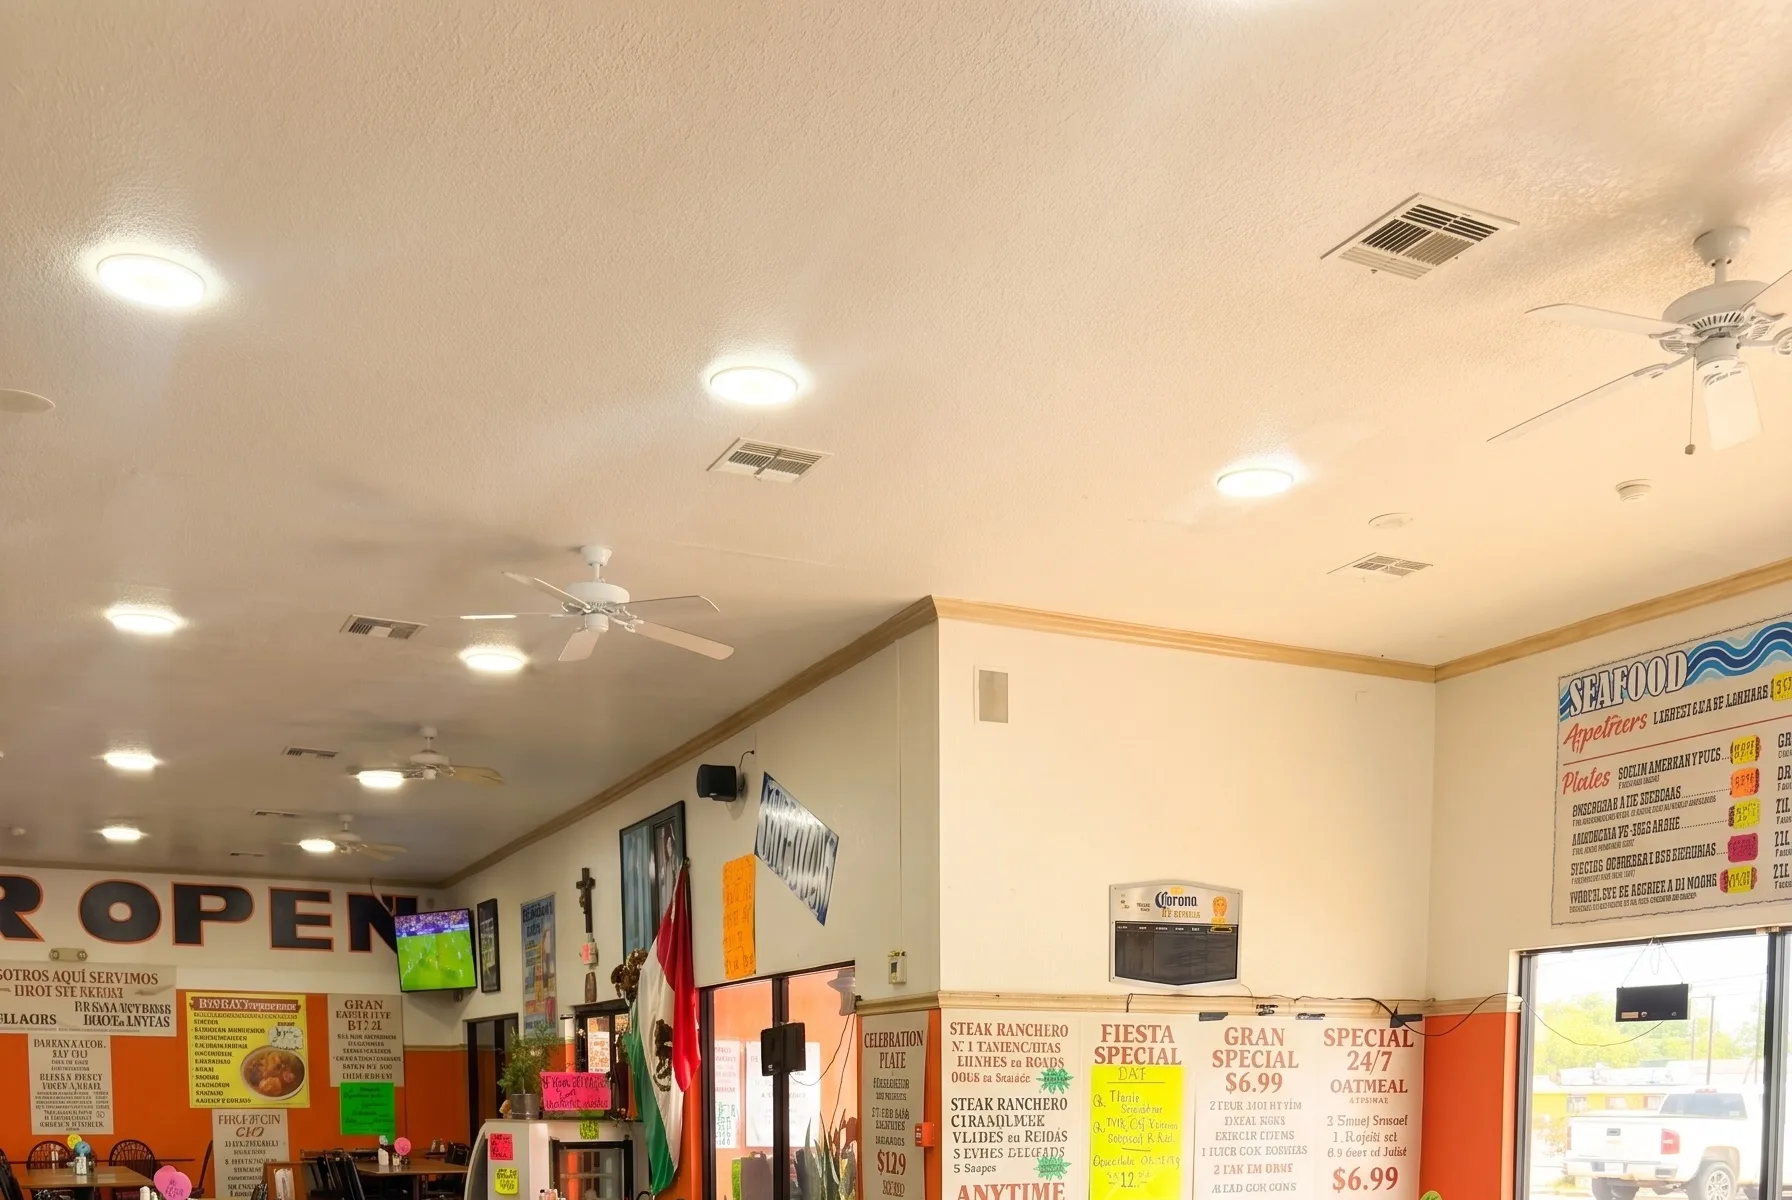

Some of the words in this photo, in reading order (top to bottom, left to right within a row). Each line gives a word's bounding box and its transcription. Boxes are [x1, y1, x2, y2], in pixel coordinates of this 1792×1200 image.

[1568, 650, 1688, 717] SEAFOOD
[1155, 891, 1197, 908] Corona
[78, 878, 418, 953] OPEN
[89, 971, 159, 985] SERVIMOS
[344, 999, 384, 1010] GRAN
[864, 1030, 924, 1049] CELEBRATION
[949, 1021, 993, 1037] STEAK
[996, 1022, 1069, 1038] RANCHERO
[1100, 1024, 1175, 1044] FIESTA
[1224, 1026, 1285, 1047] GRAN
[1323, 1028, 1415, 1048] SPECIAL
[1094, 1046, 1182, 1065] SPECIAL
[1212, 1049, 1299, 1069] SPECIAL
[1346, 1050, 1393, 1075] 24/7
[1225, 1072, 1283, 1094] $6.99
[1330, 1079, 1408, 1094] OATMEAL
[951, 1097, 993, 1111] STEAK
[997, 1098, 1068, 1111] RANCHERO
[1332, 1166, 1398, 1194] $6.99
